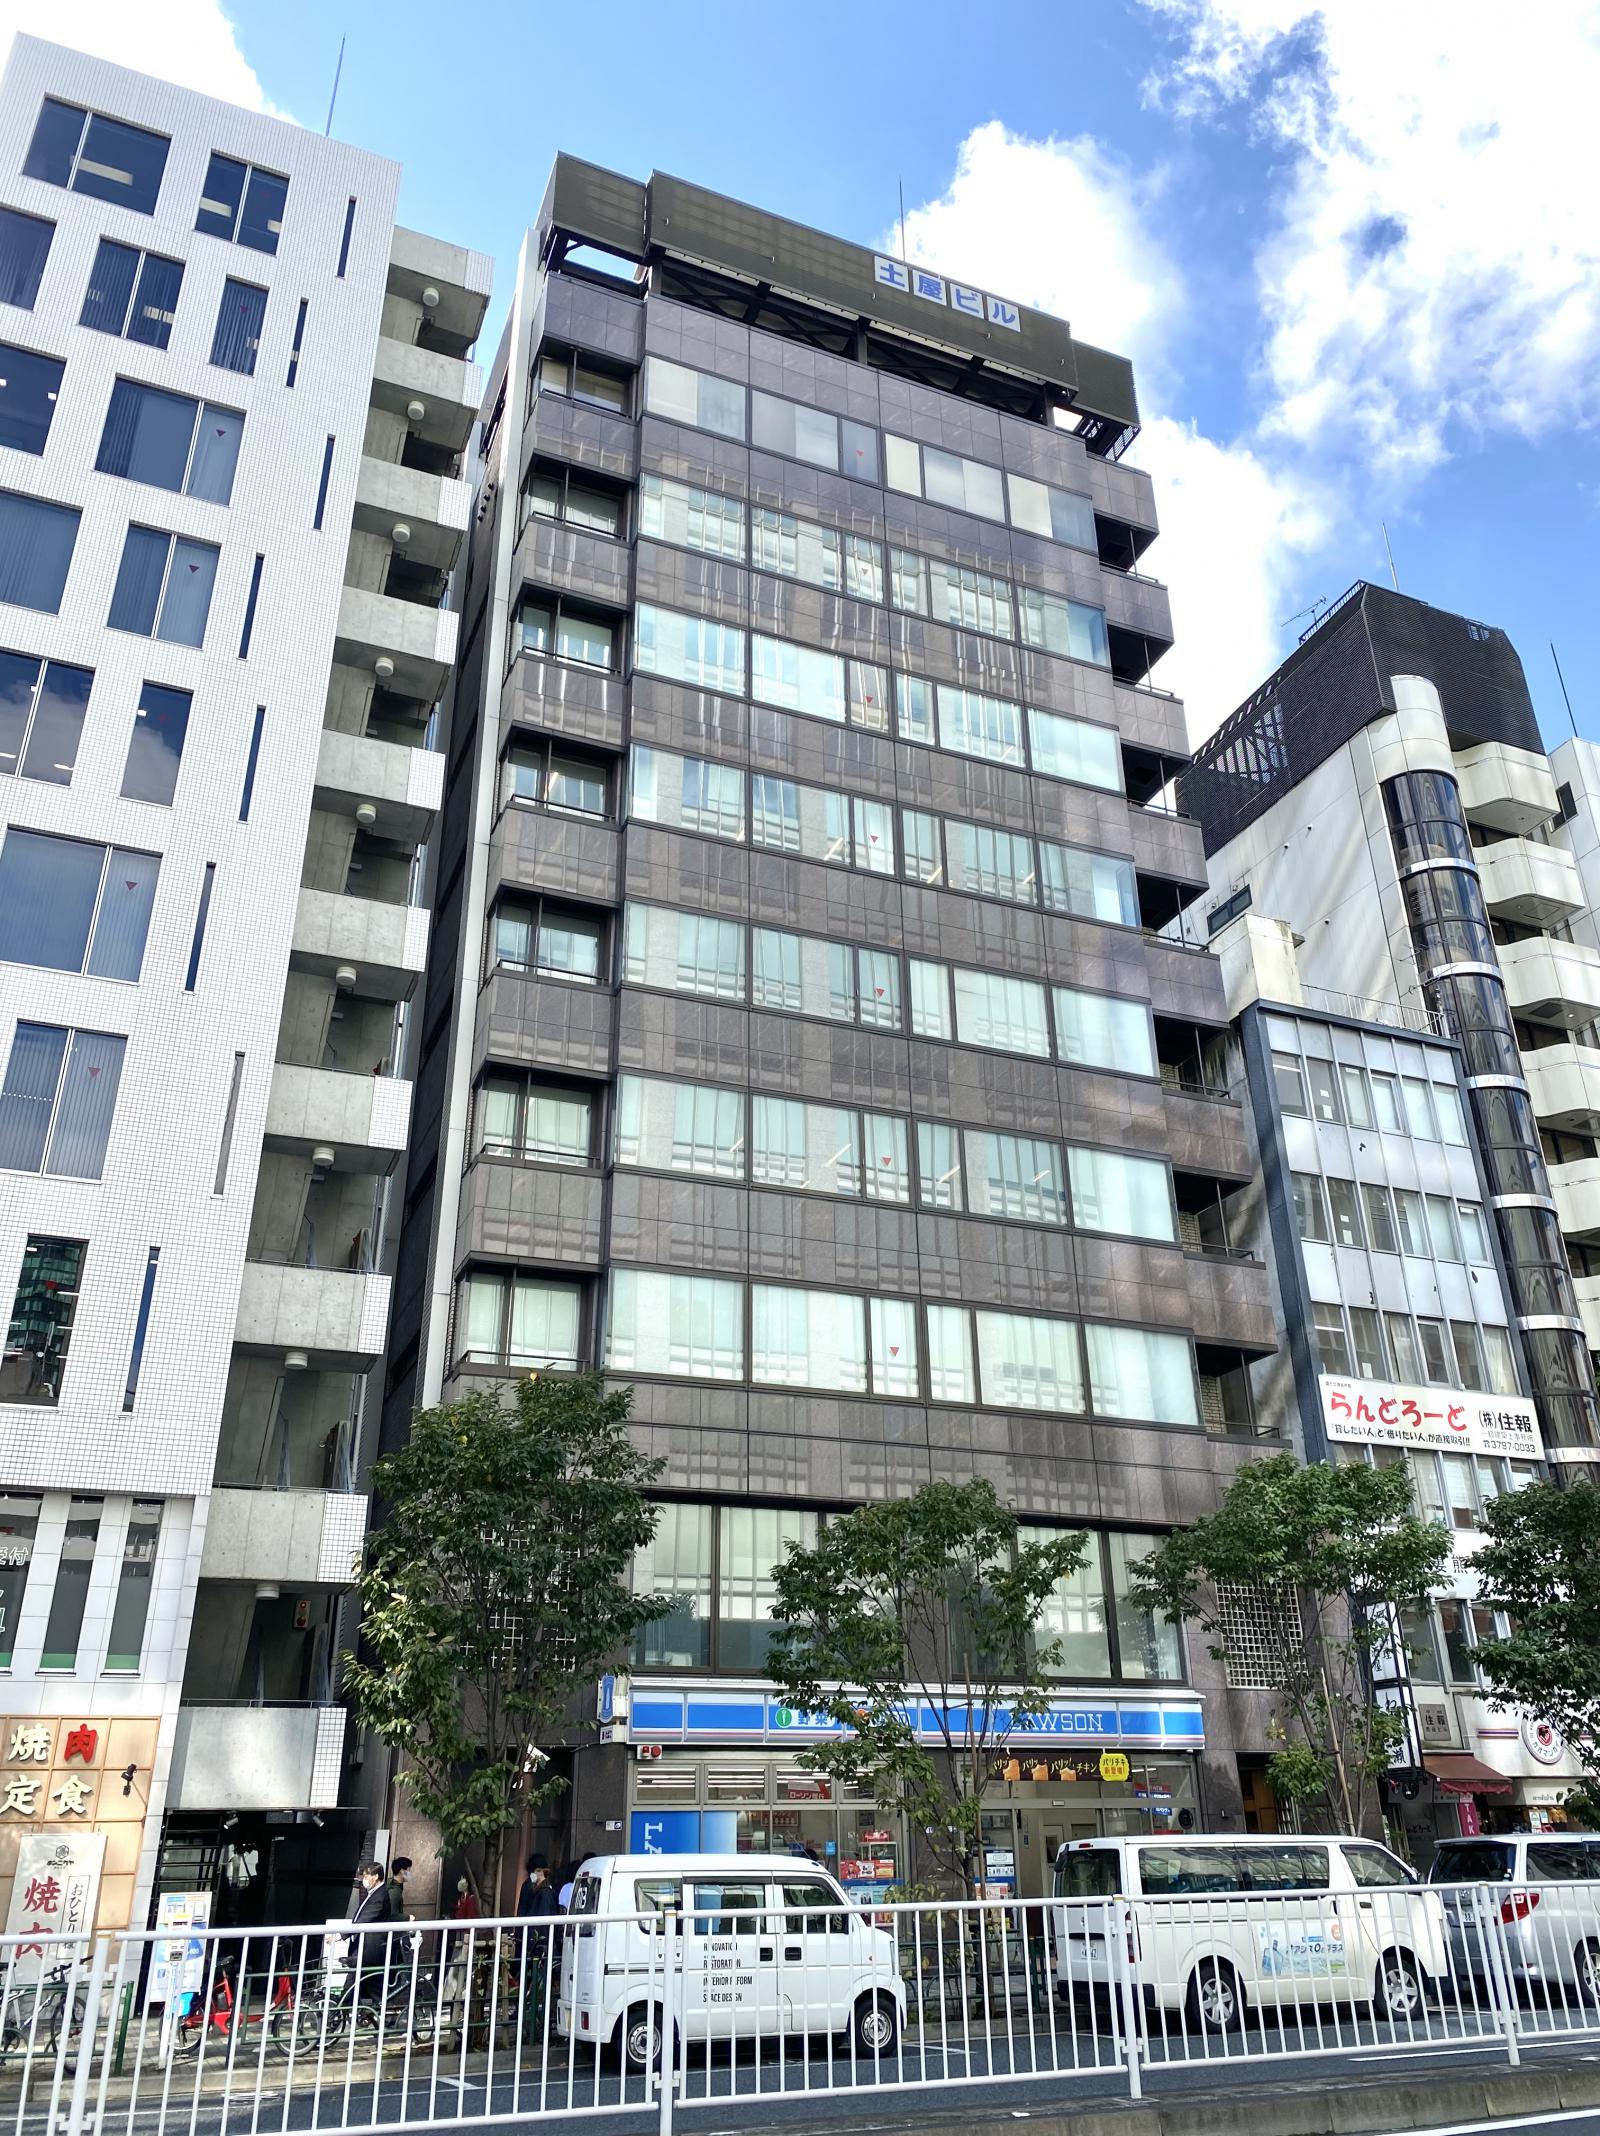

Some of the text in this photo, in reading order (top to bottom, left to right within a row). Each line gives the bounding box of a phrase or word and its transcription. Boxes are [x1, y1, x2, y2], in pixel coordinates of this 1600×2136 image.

[880, 264, 1015, 323] 土屋ビル
[1331, 1391, 1467, 1431] らんどろーど
[8, 1722, 98, 1764] 焼肉
[0, 1774, 92, 1815] 定食
[16, 1876, 61, 1960] 焼肉
[703, 1958, 741, 1969] RSTORATIN
[702, 1992, 743, 2003] SACE DESGN
